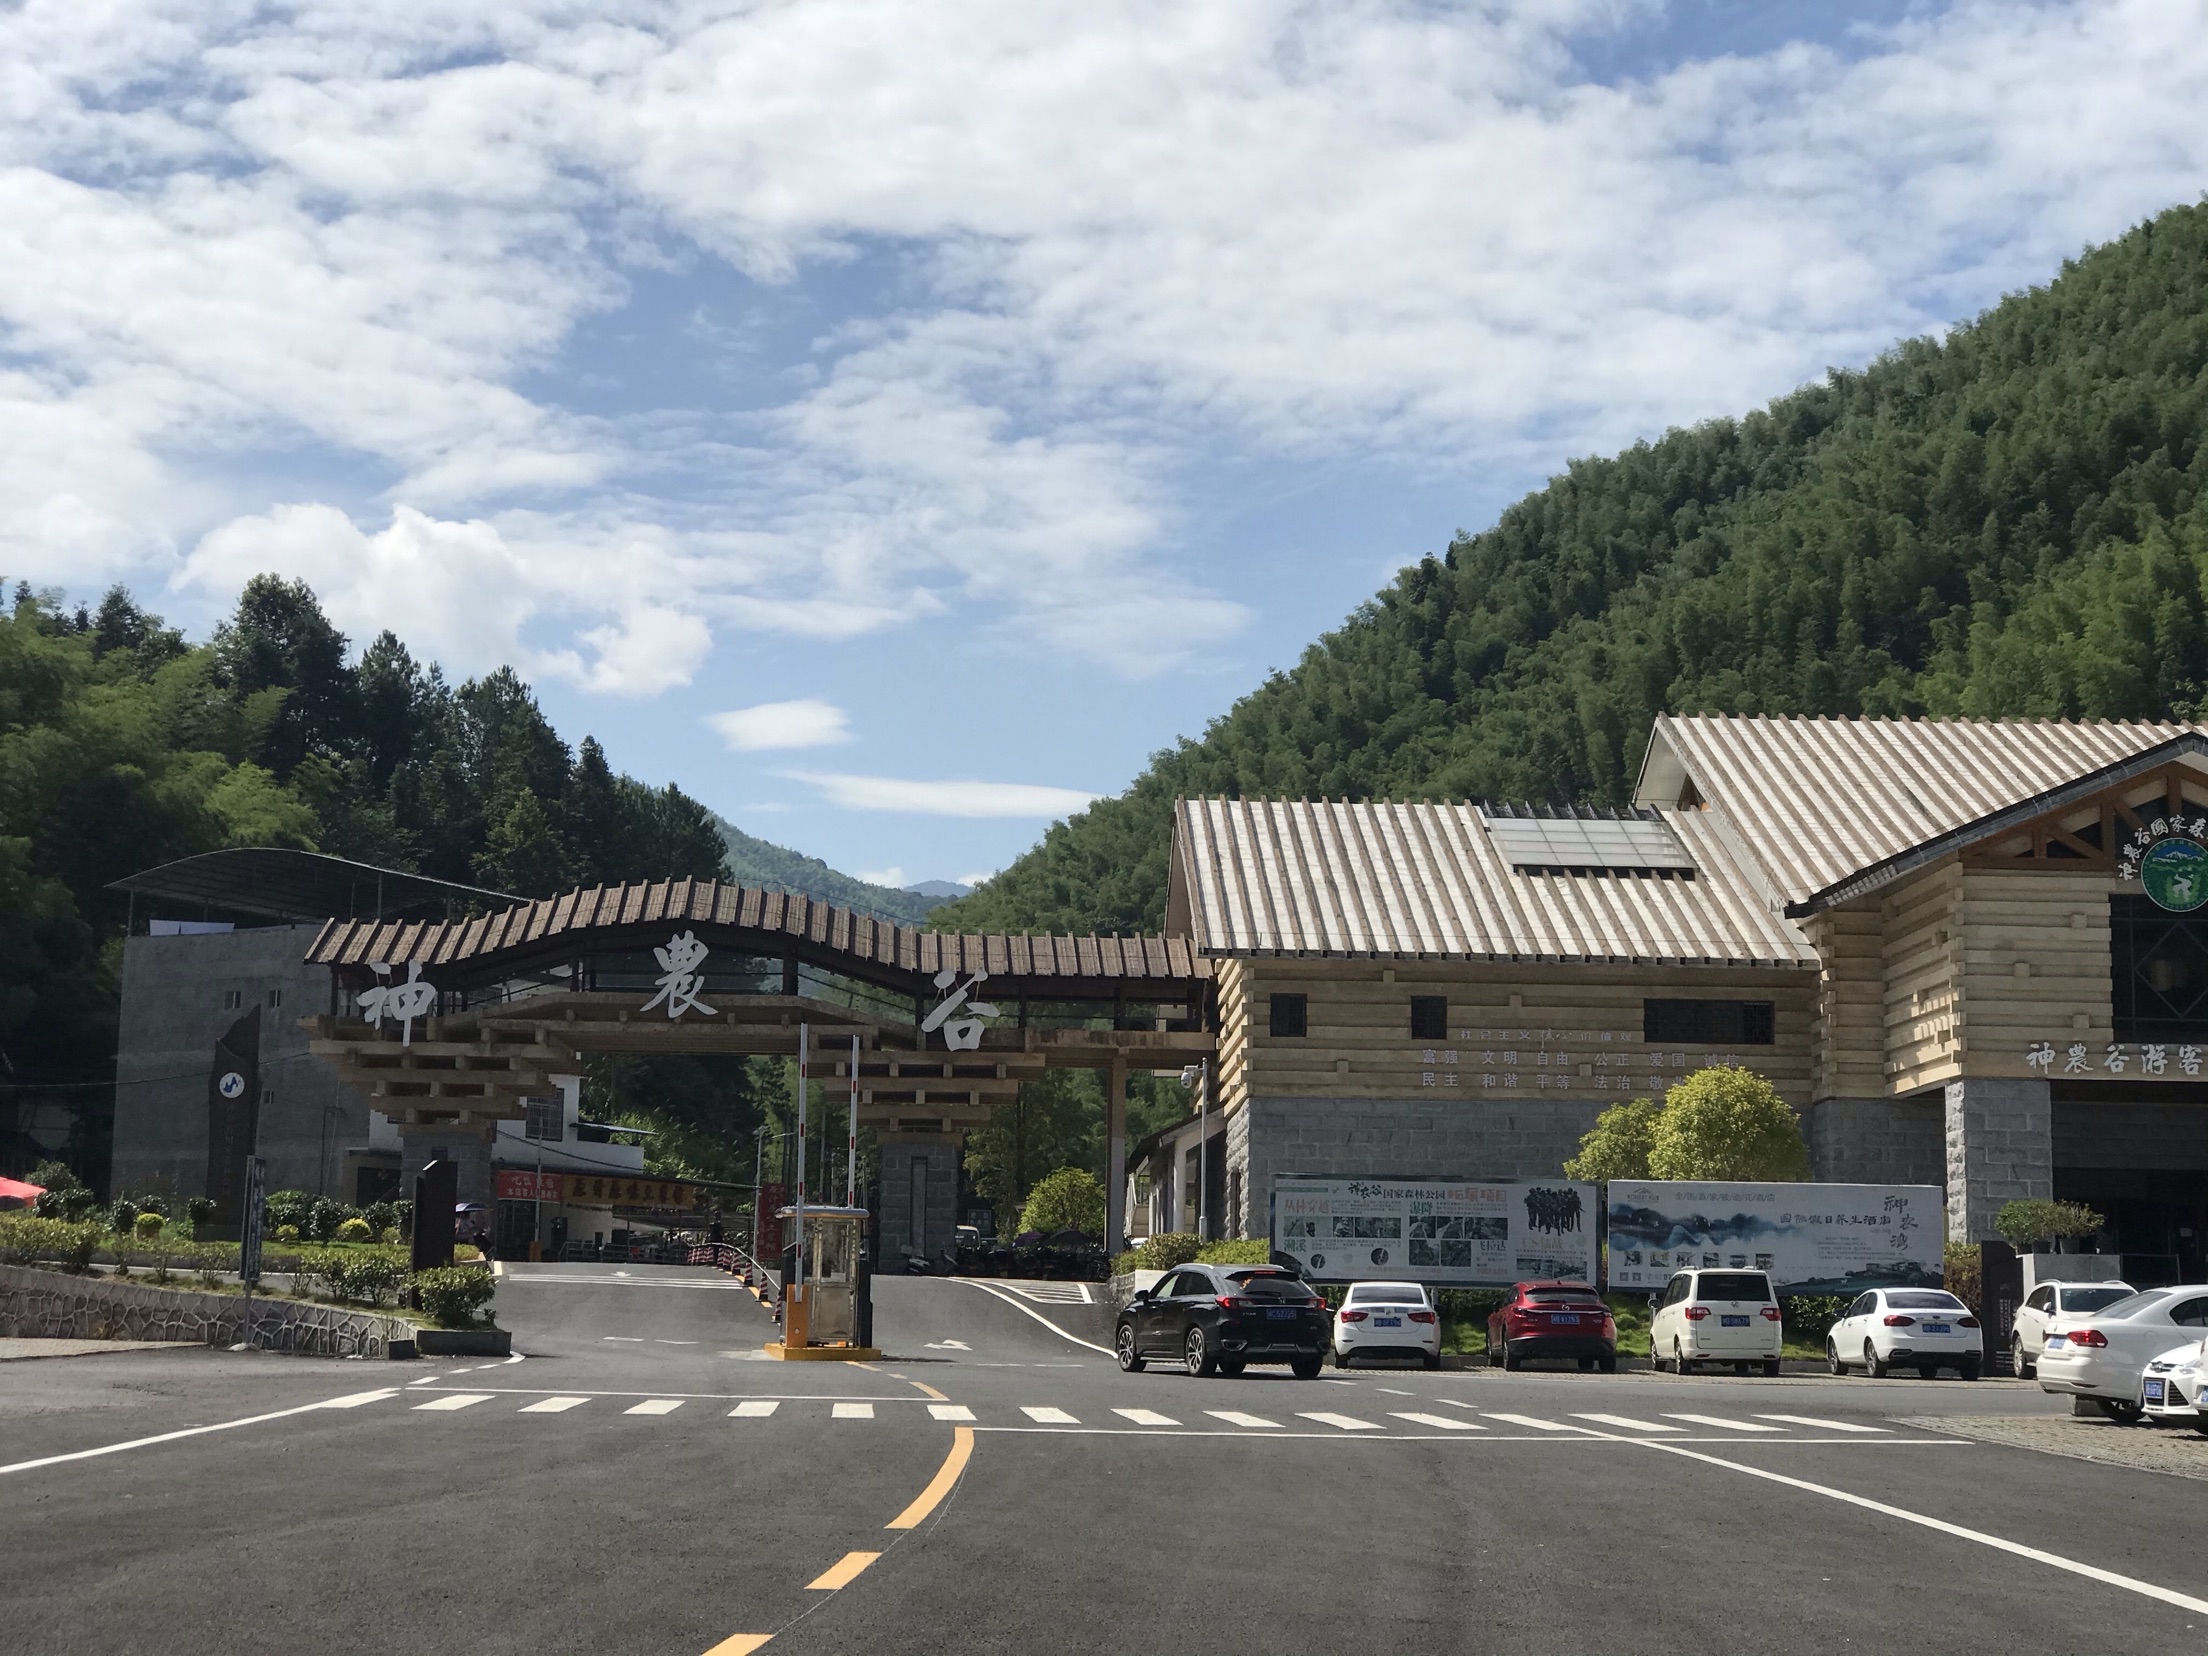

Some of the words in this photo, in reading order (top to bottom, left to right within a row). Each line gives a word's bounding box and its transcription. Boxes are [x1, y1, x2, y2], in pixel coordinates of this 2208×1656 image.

[1423, 1049, 1458, 1065] 富强
[1482, 1050, 1518, 1065] 文明
[1537, 1051, 1569, 1065] 自由
[1595, 1052, 1630, 1067] 公正
[1650, 1052, 1685, 1067] 爱国
[1422, 1072, 1458, 1087] 民主
[1482, 1073, 1518, 1088] 和谐
[1536, 1074, 1570, 1089] 平等
[1595, 1075, 1630, 1090] 法治
